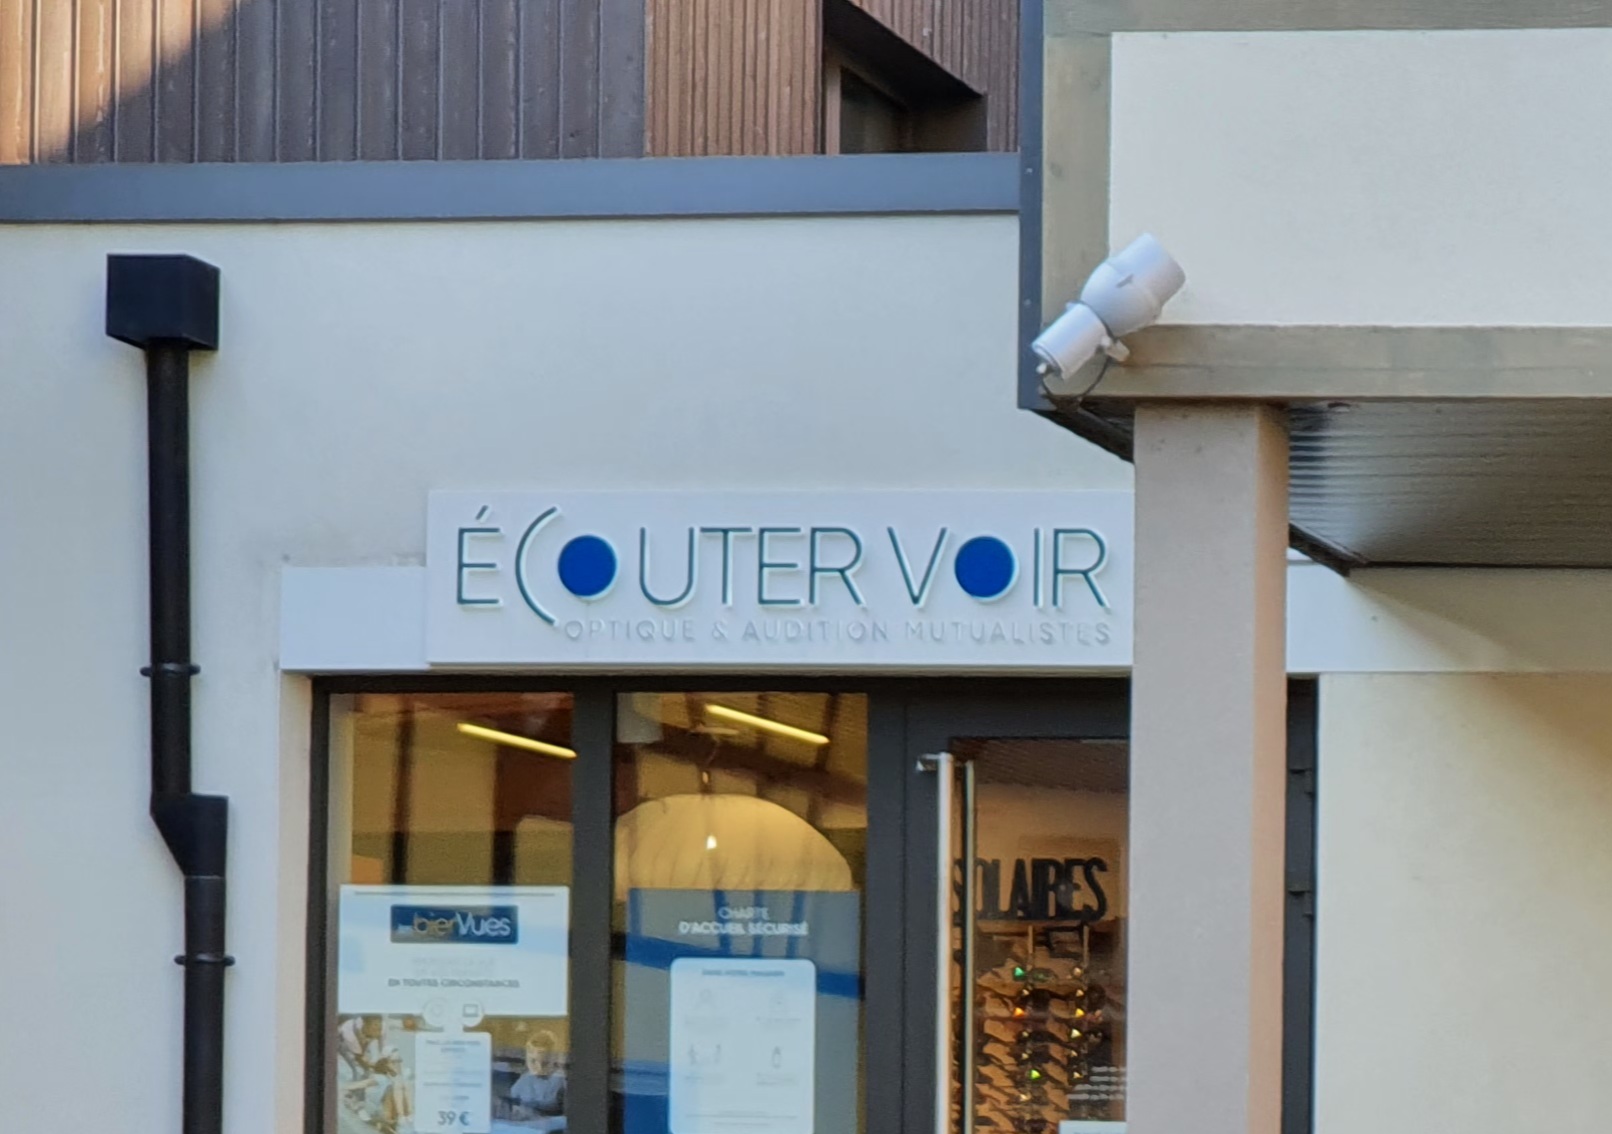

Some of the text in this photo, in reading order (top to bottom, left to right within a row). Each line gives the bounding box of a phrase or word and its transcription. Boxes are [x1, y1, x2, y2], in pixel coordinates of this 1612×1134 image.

[455, 505, 1111, 626] ÉCOUTER VOIR
[564, 619, 1112, 646] OPTIQUE & AUDITION MUTUALISTES
